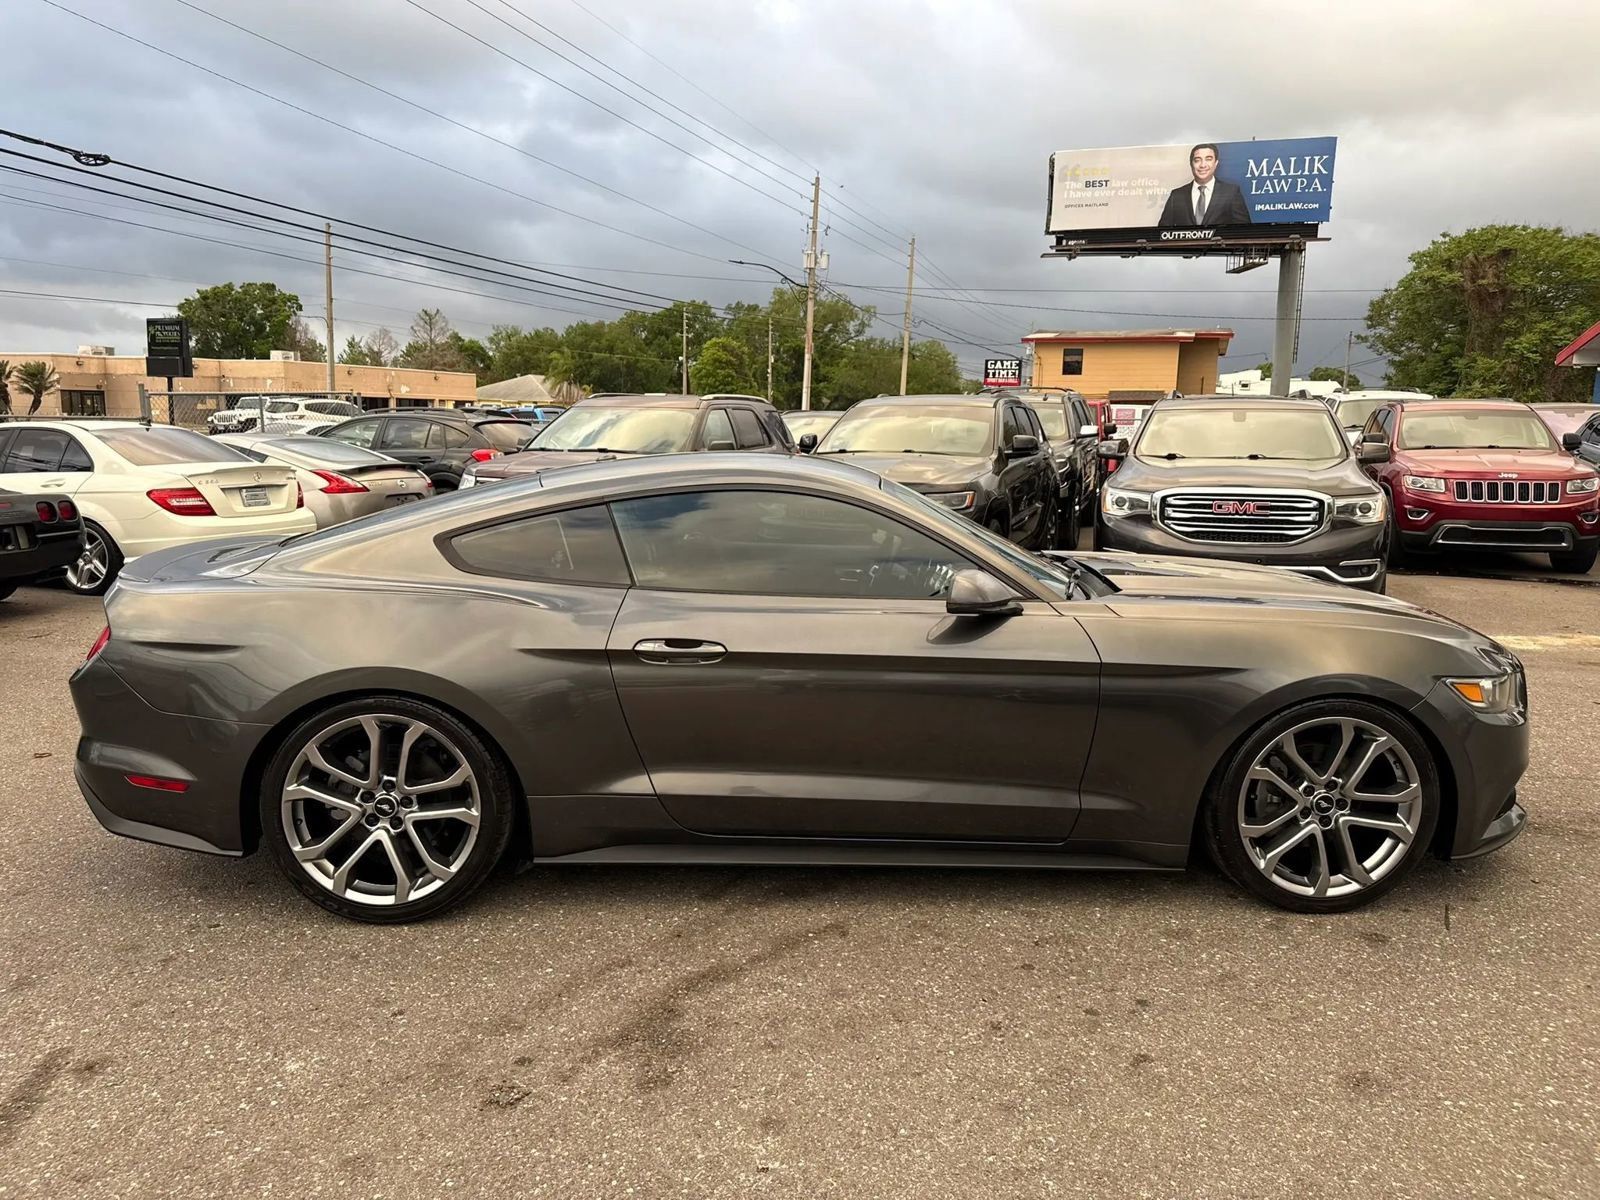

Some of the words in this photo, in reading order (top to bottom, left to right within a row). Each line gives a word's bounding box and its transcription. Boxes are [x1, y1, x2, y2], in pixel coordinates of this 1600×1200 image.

[1245, 155, 1329, 178] MALIK
[1064, 181, 1082, 190] The
[1084, 179, 1110, 188] BEST
[1131, 178, 1160, 187] office
[1250, 179, 1292, 195] LAW
[1295, 177, 1327, 193] P.A.
[1069, 190, 1092, 198] have
[1118, 188, 1143, 196] dealt
[987, 360, 1020, 369] GAME
[987, 369, 1019, 378] TIME!
[1212, 500, 1271, 515] GMC
